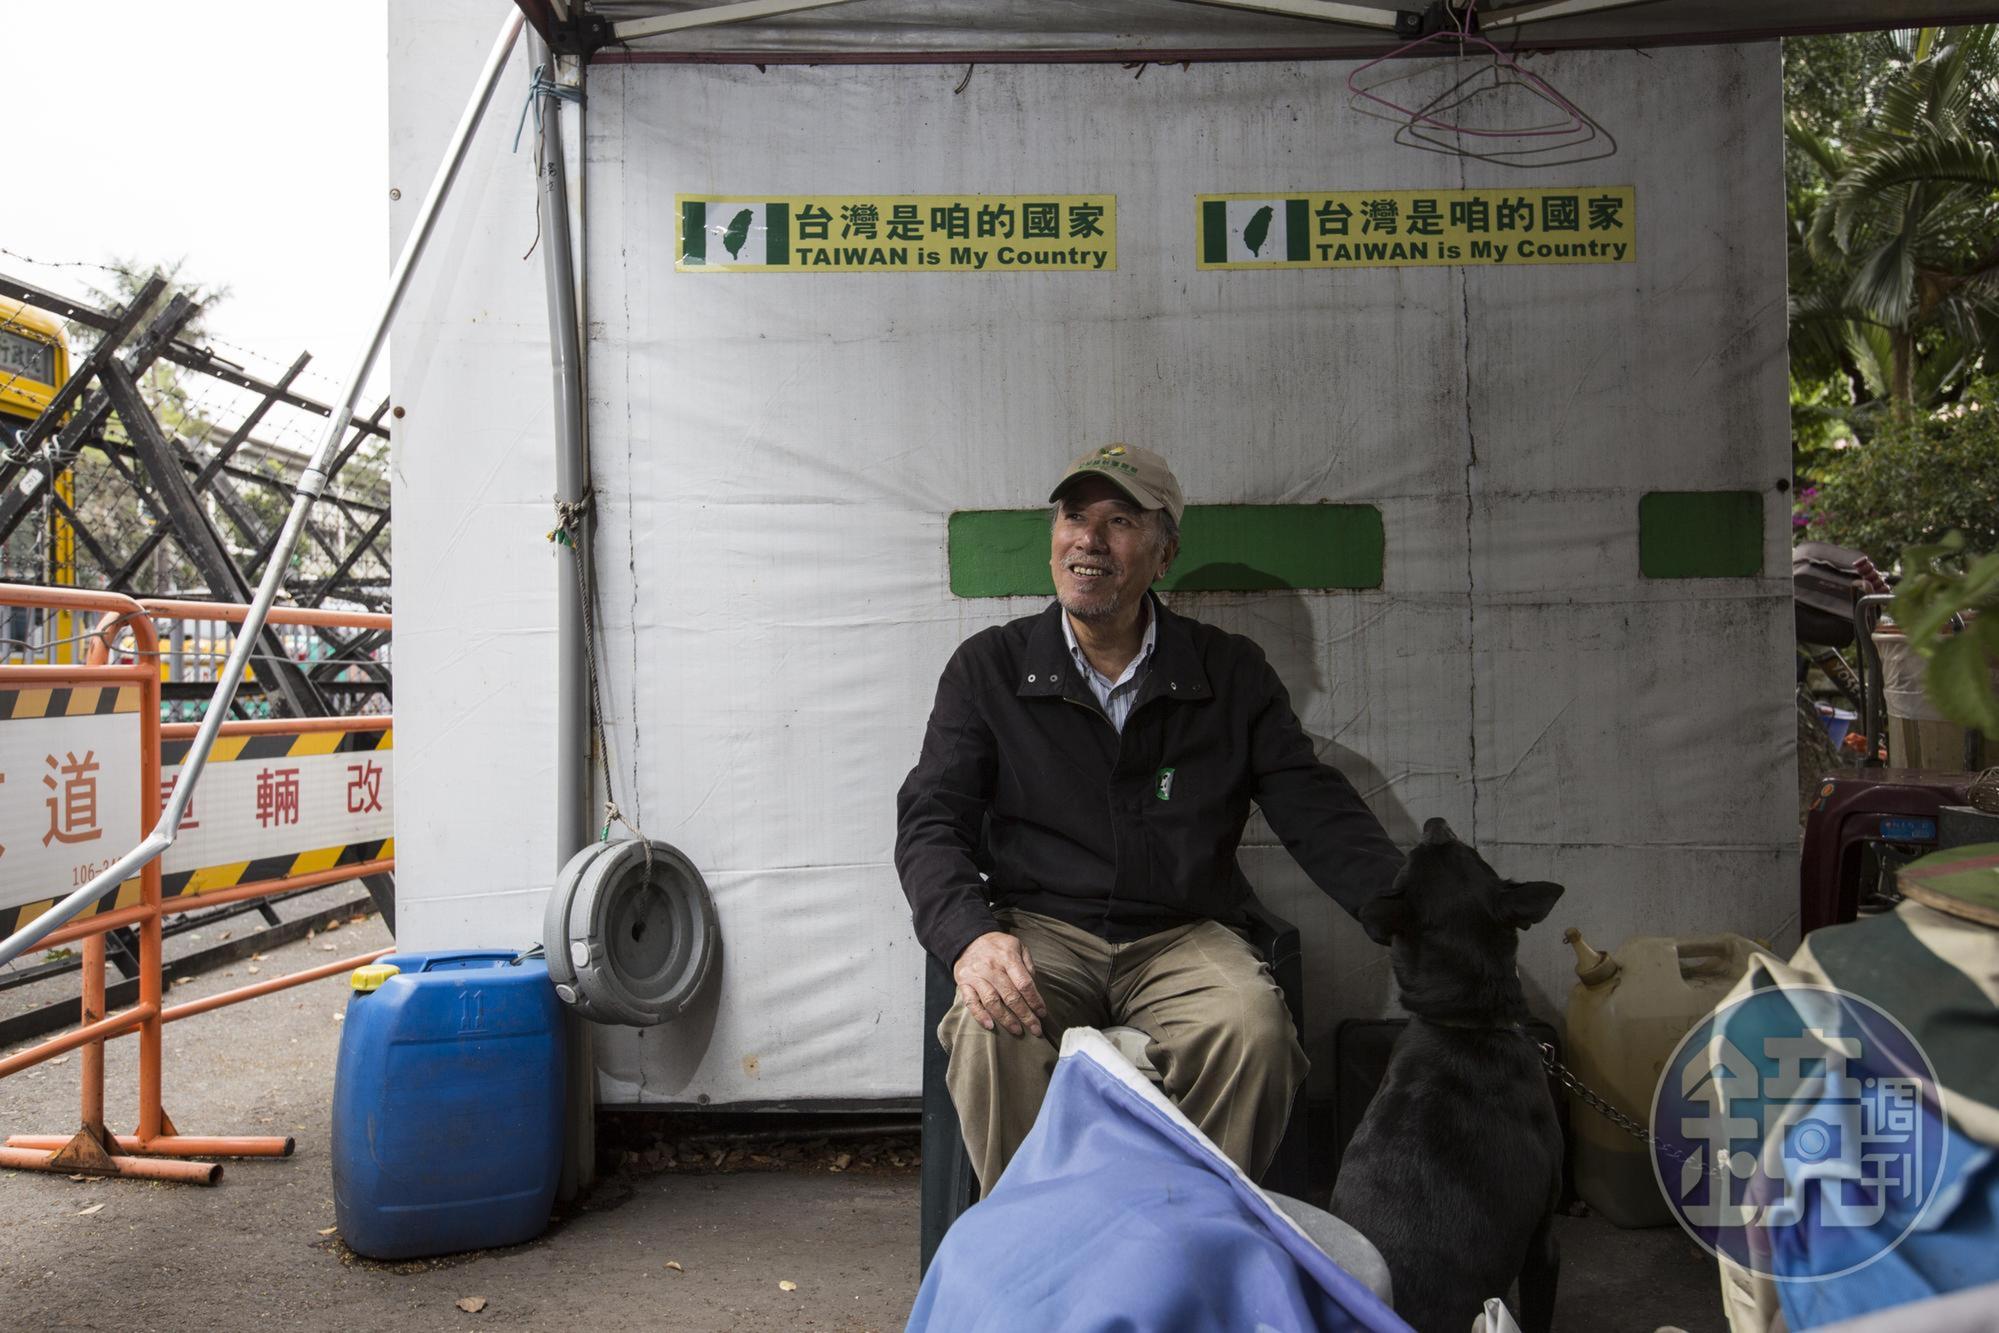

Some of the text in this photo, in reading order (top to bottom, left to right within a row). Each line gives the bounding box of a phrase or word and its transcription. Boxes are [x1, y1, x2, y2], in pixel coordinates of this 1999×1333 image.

[795, 203, 1105, 240] 台灣是咱的國家
[1314, 194, 1624, 236] 台灣是咱的國家
[796, 246, 1108, 269] TAIWAN is My Country
[1316, 239, 1628, 263] TAIWAN is My Country
